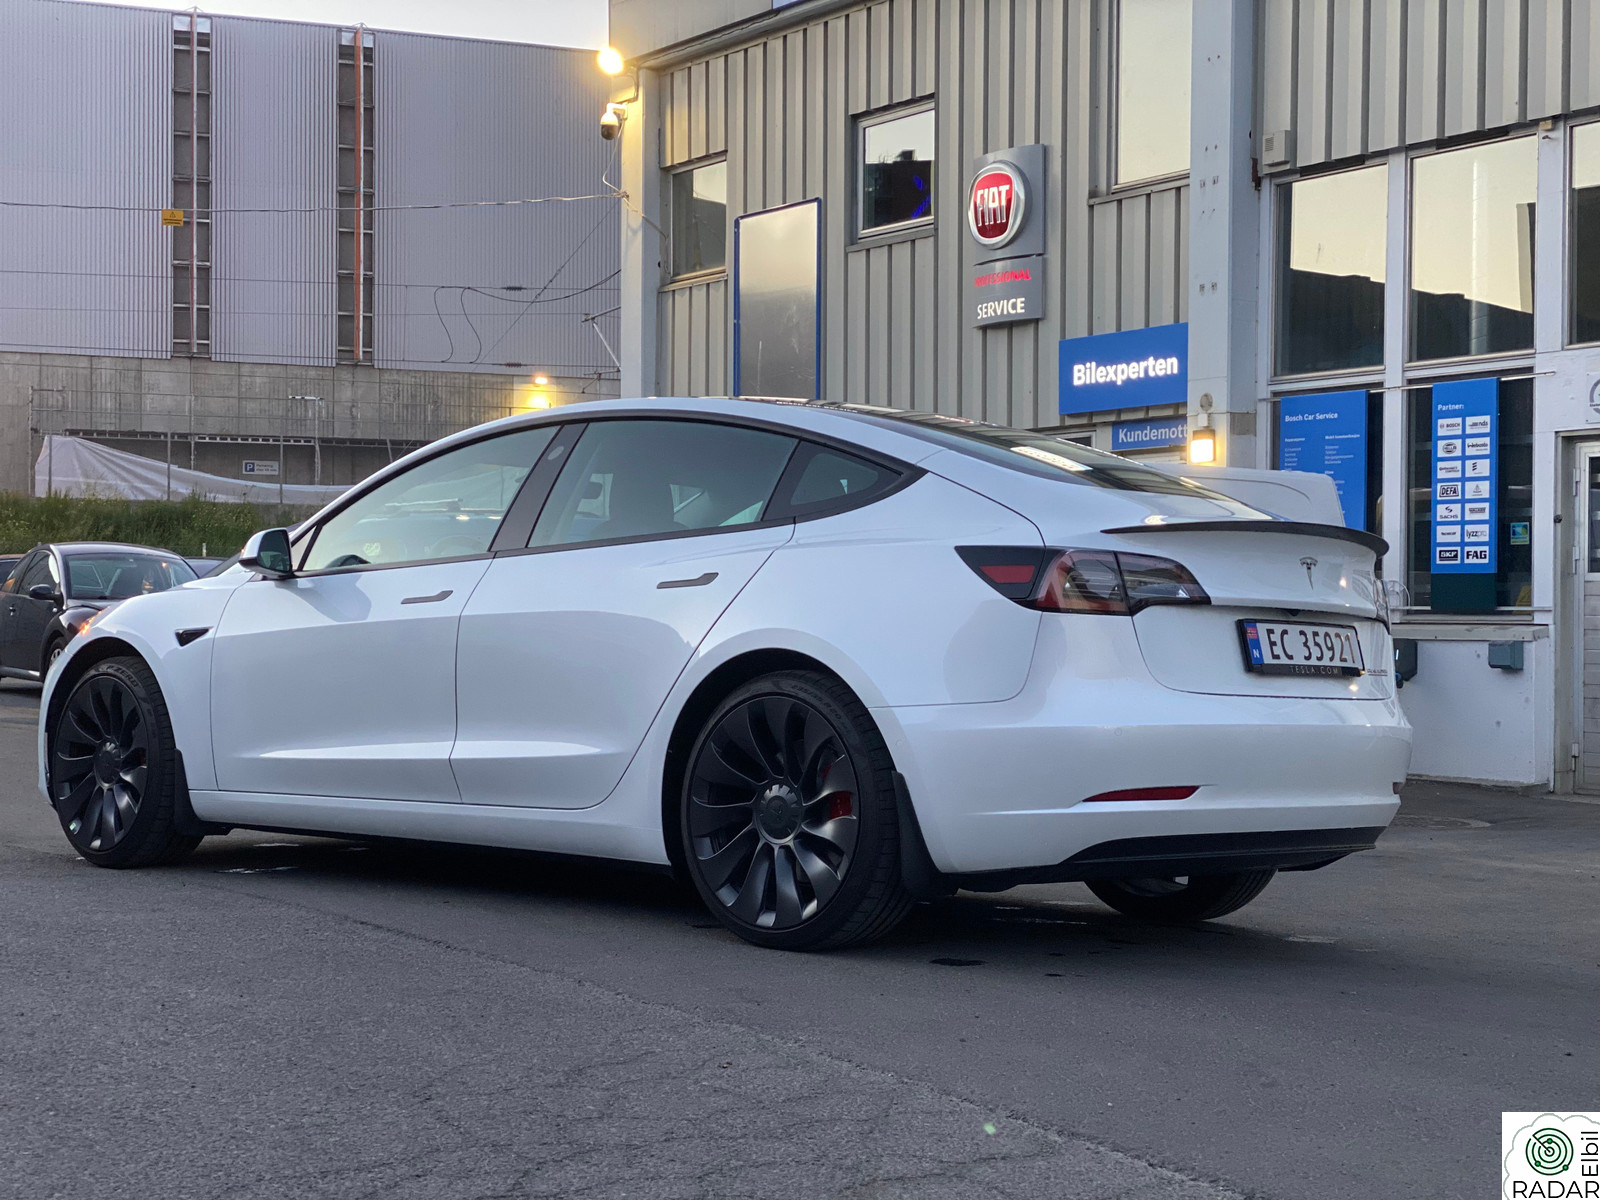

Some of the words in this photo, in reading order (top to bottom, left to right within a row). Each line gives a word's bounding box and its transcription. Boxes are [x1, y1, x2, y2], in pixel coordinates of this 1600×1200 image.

[976, 184, 1010, 227] FIAT
[977, 297, 1026, 320] SERVICE
[1073, 356, 1179, 386] Bilexperten
[1284, 414, 1303, 422] Bosch
[1304, 413, 1315, 421] Car
[1315, 411, 1339, 420] Service
[1441, 486, 1457, 496] DEFA
[1466, 550, 1488, 560] FAG
[1266, 628, 1294, 660] EC
[1299, 629, 1356, 664] 35921
[1253, 649, 1260, 658] N
[1290, 665, 1339, 675] TESLA.COM
